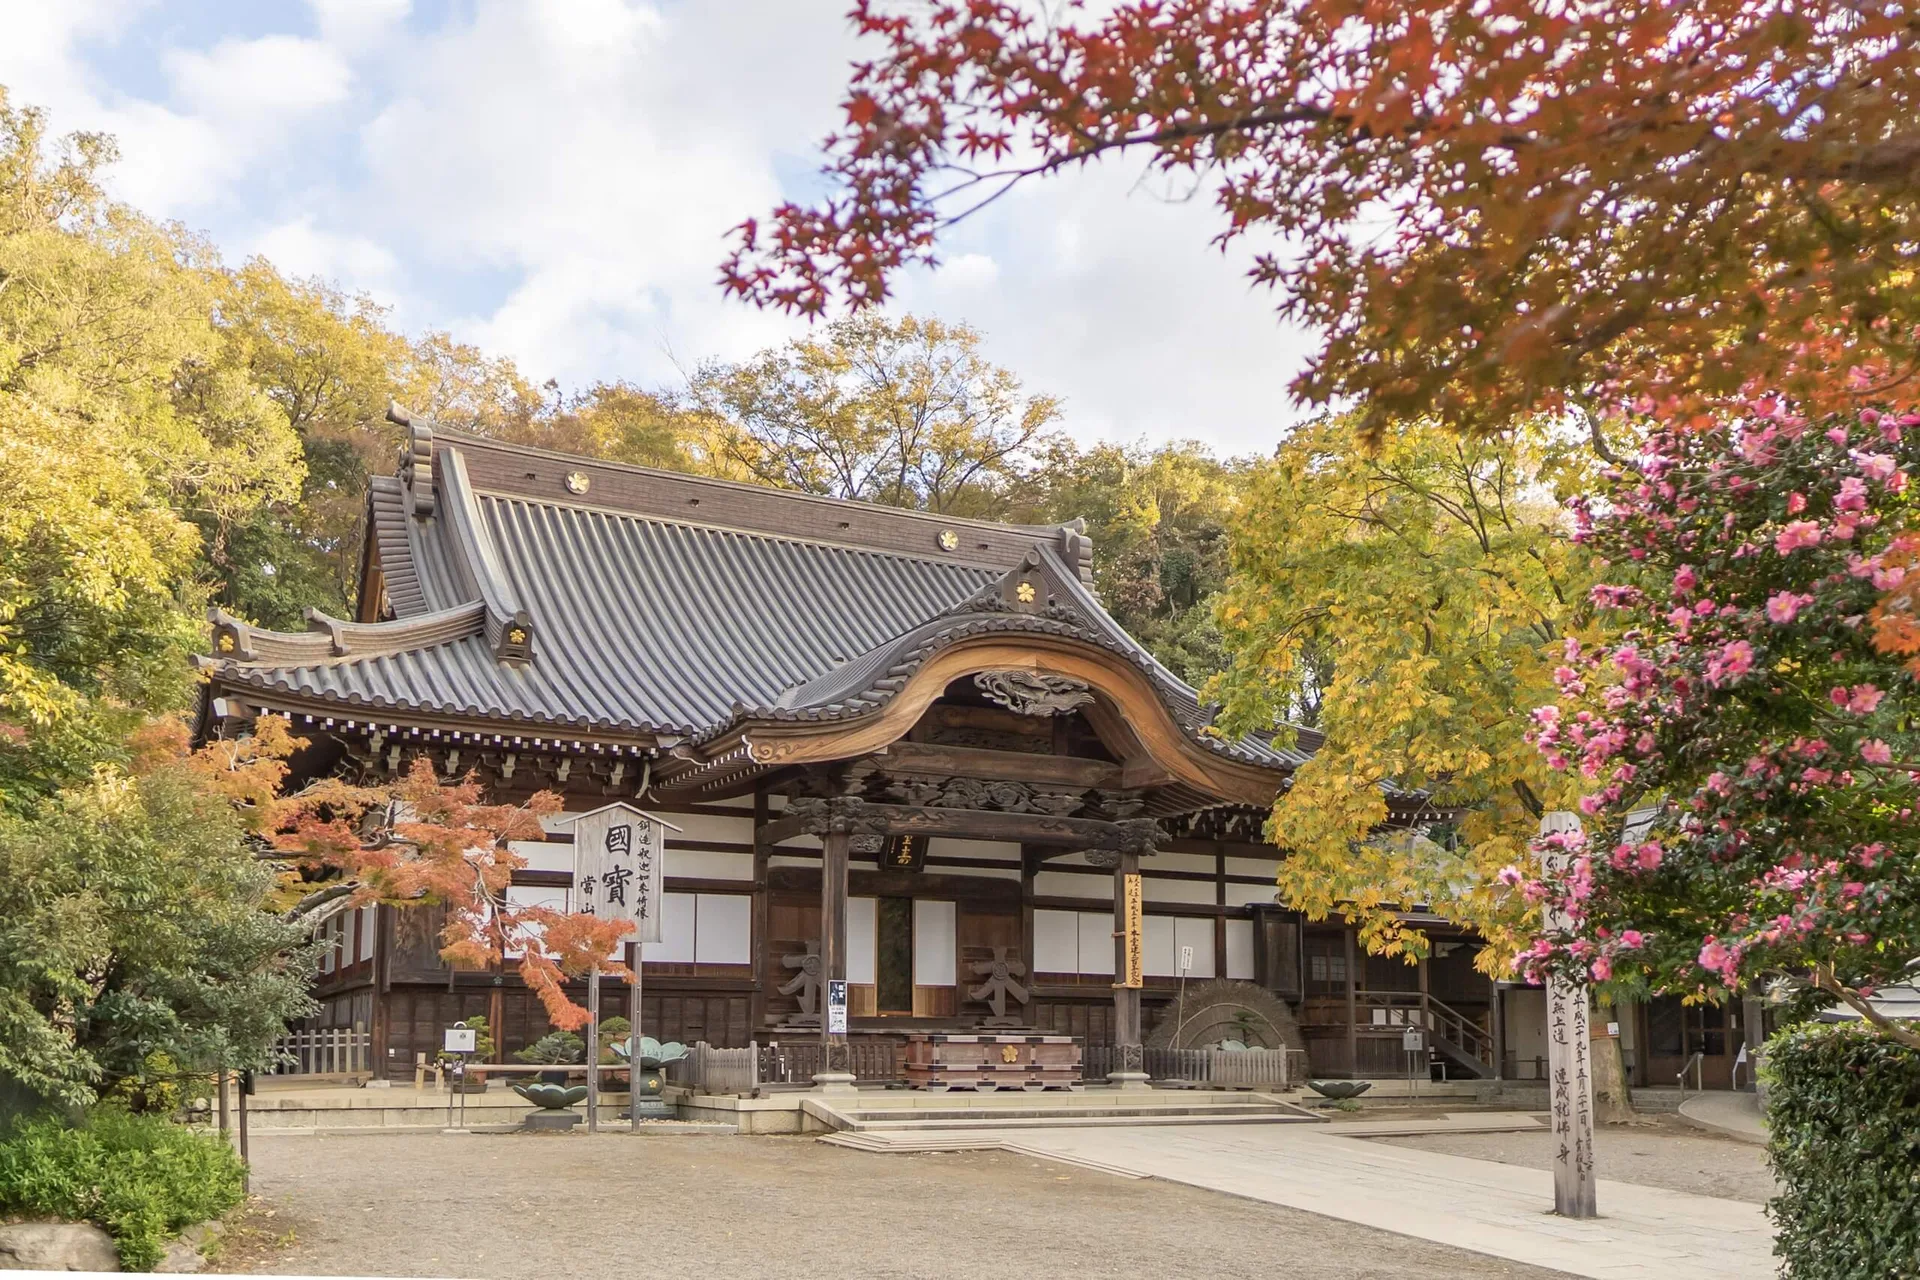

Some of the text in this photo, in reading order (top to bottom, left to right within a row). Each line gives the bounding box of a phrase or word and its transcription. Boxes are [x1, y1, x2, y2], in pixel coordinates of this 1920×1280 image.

[602, 824, 633, 908] 國寶
[1572, 994, 1588, 1127] 平成二十九年五月二十一日
